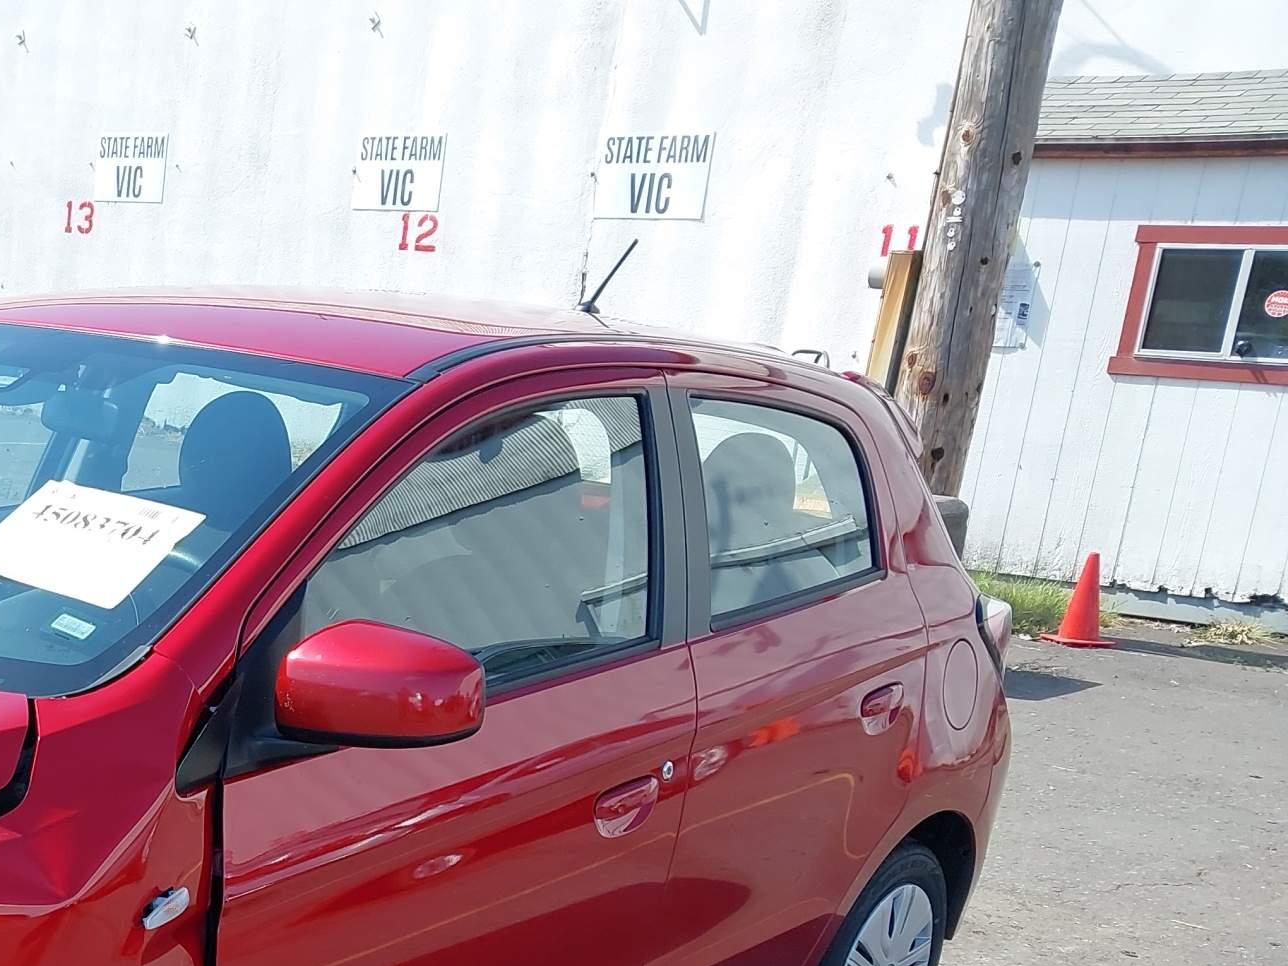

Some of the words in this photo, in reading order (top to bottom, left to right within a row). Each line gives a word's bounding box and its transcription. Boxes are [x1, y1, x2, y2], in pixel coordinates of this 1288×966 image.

[100, 136, 130, 159] STATE
[132, 136, 165, 159] FARM
[361, 136, 399, 161] STATE
[401, 135, 443, 161] FARM
[604, 136, 655, 164] STATE
[656, 134, 711, 163] FARM
[116, 165, 143, 198] VIC
[380, 169, 414, 206] VIC
[630, 172, 673, 214] VIC
[64, 200, 95, 234] 13
[398, 213, 439, 252] 12
[880, 223, 920, 257] 11
[32, 504, 161, 545] 45083704
